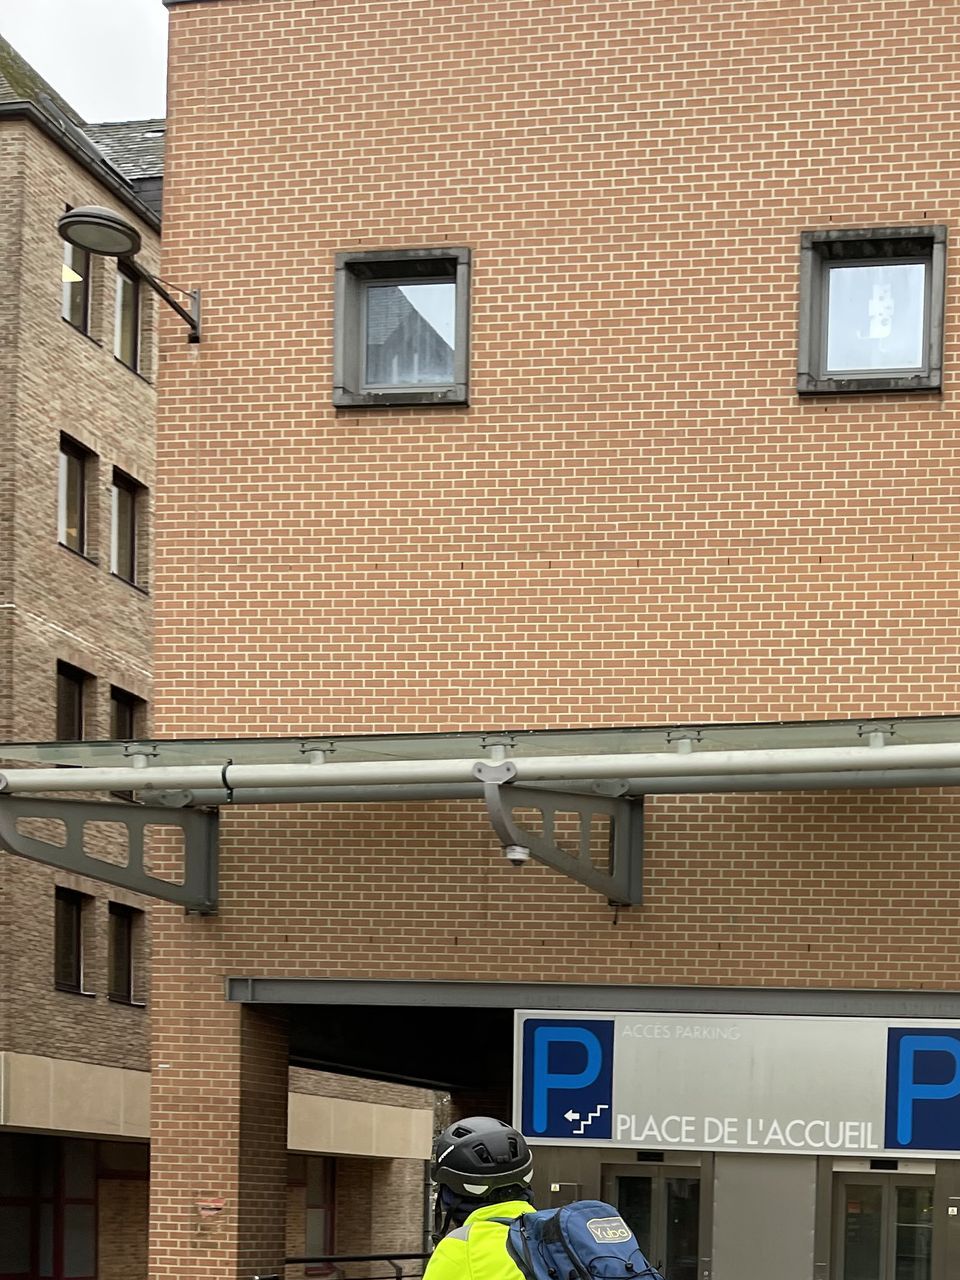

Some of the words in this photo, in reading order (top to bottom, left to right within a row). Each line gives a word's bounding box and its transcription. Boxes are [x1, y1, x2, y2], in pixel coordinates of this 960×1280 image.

[622, 1023, 671, 1039] ACCÈS
[675, 1024, 742, 1041] PARKING
[533, 1026, 602, 1134] P
[616, 1114, 696, 1143] PLACE
[704, 1117, 738, 1144] DE
[746, 1118, 879, 1149] L'ACCUEIL
[592, 1227, 628, 1238] Yuba
